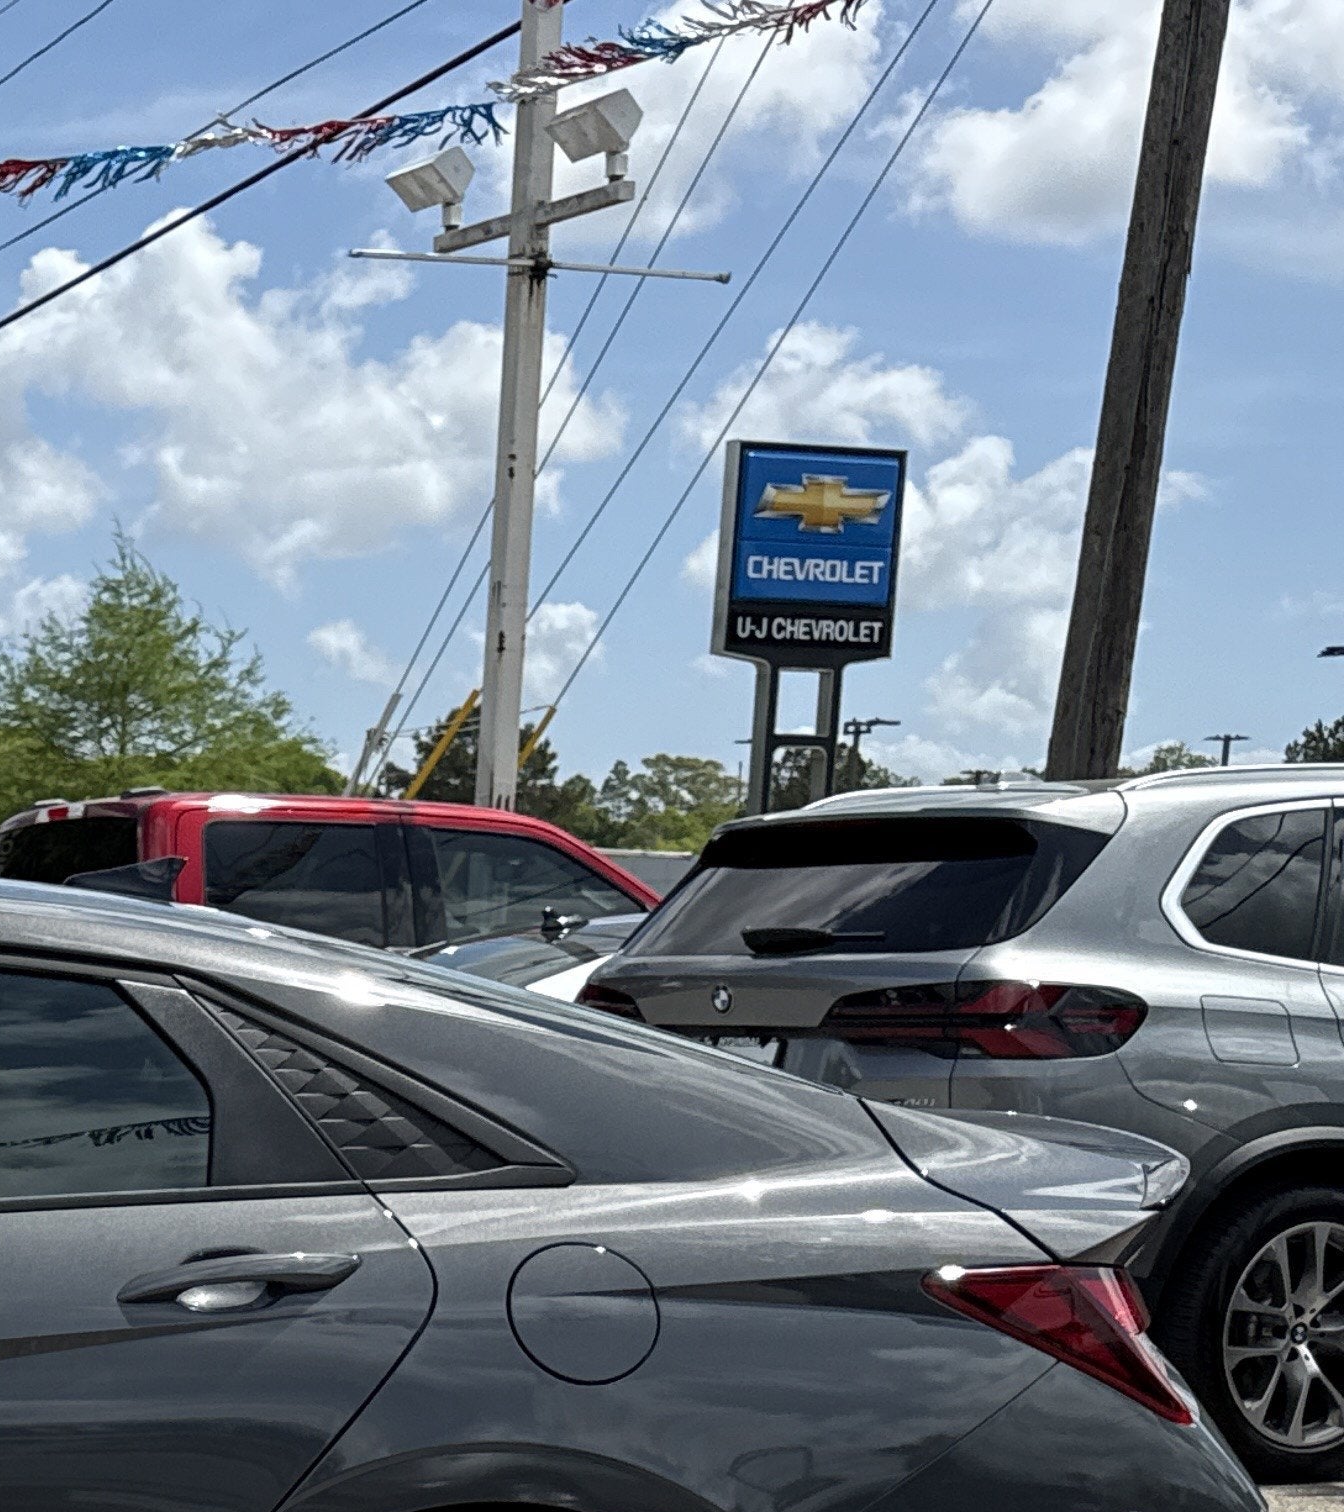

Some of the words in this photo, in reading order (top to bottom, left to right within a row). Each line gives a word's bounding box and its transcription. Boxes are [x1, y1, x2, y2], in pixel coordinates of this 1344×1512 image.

[746, 555, 885, 585] CHEVROLET
[736, 616, 769, 640] U-J
[771, 616, 884, 643] CHEVROLET
